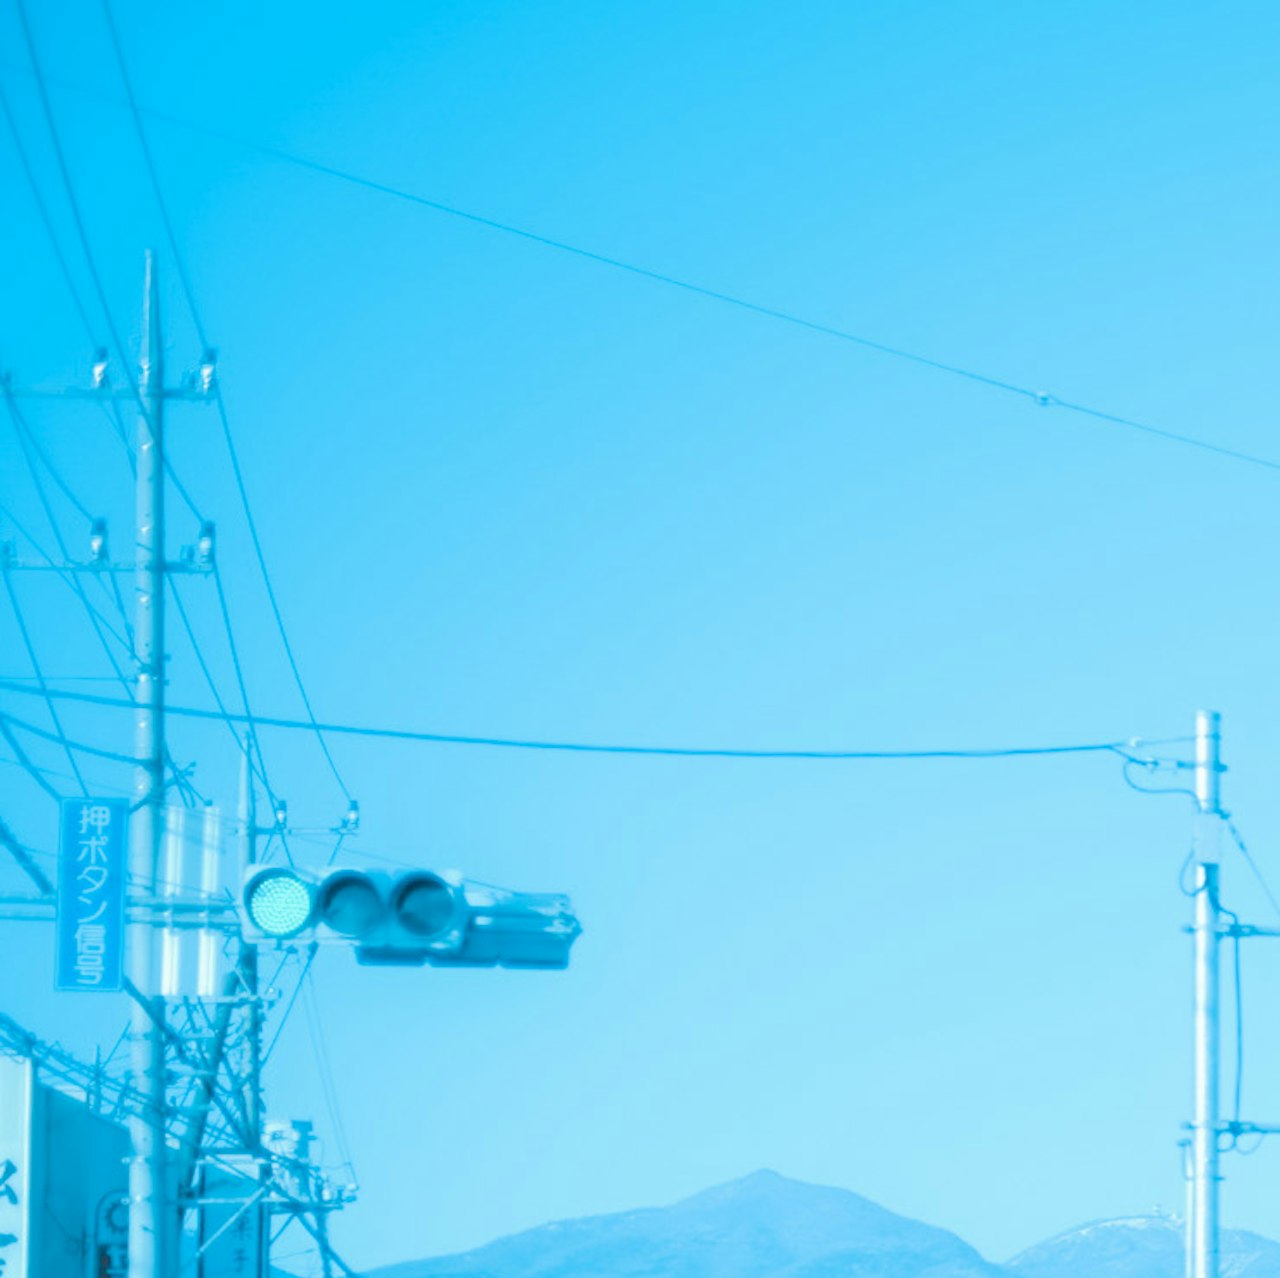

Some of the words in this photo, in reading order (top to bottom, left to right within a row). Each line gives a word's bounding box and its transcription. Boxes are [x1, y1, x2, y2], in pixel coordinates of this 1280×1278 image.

[74, 804, 112, 986] 押ボタン信号
